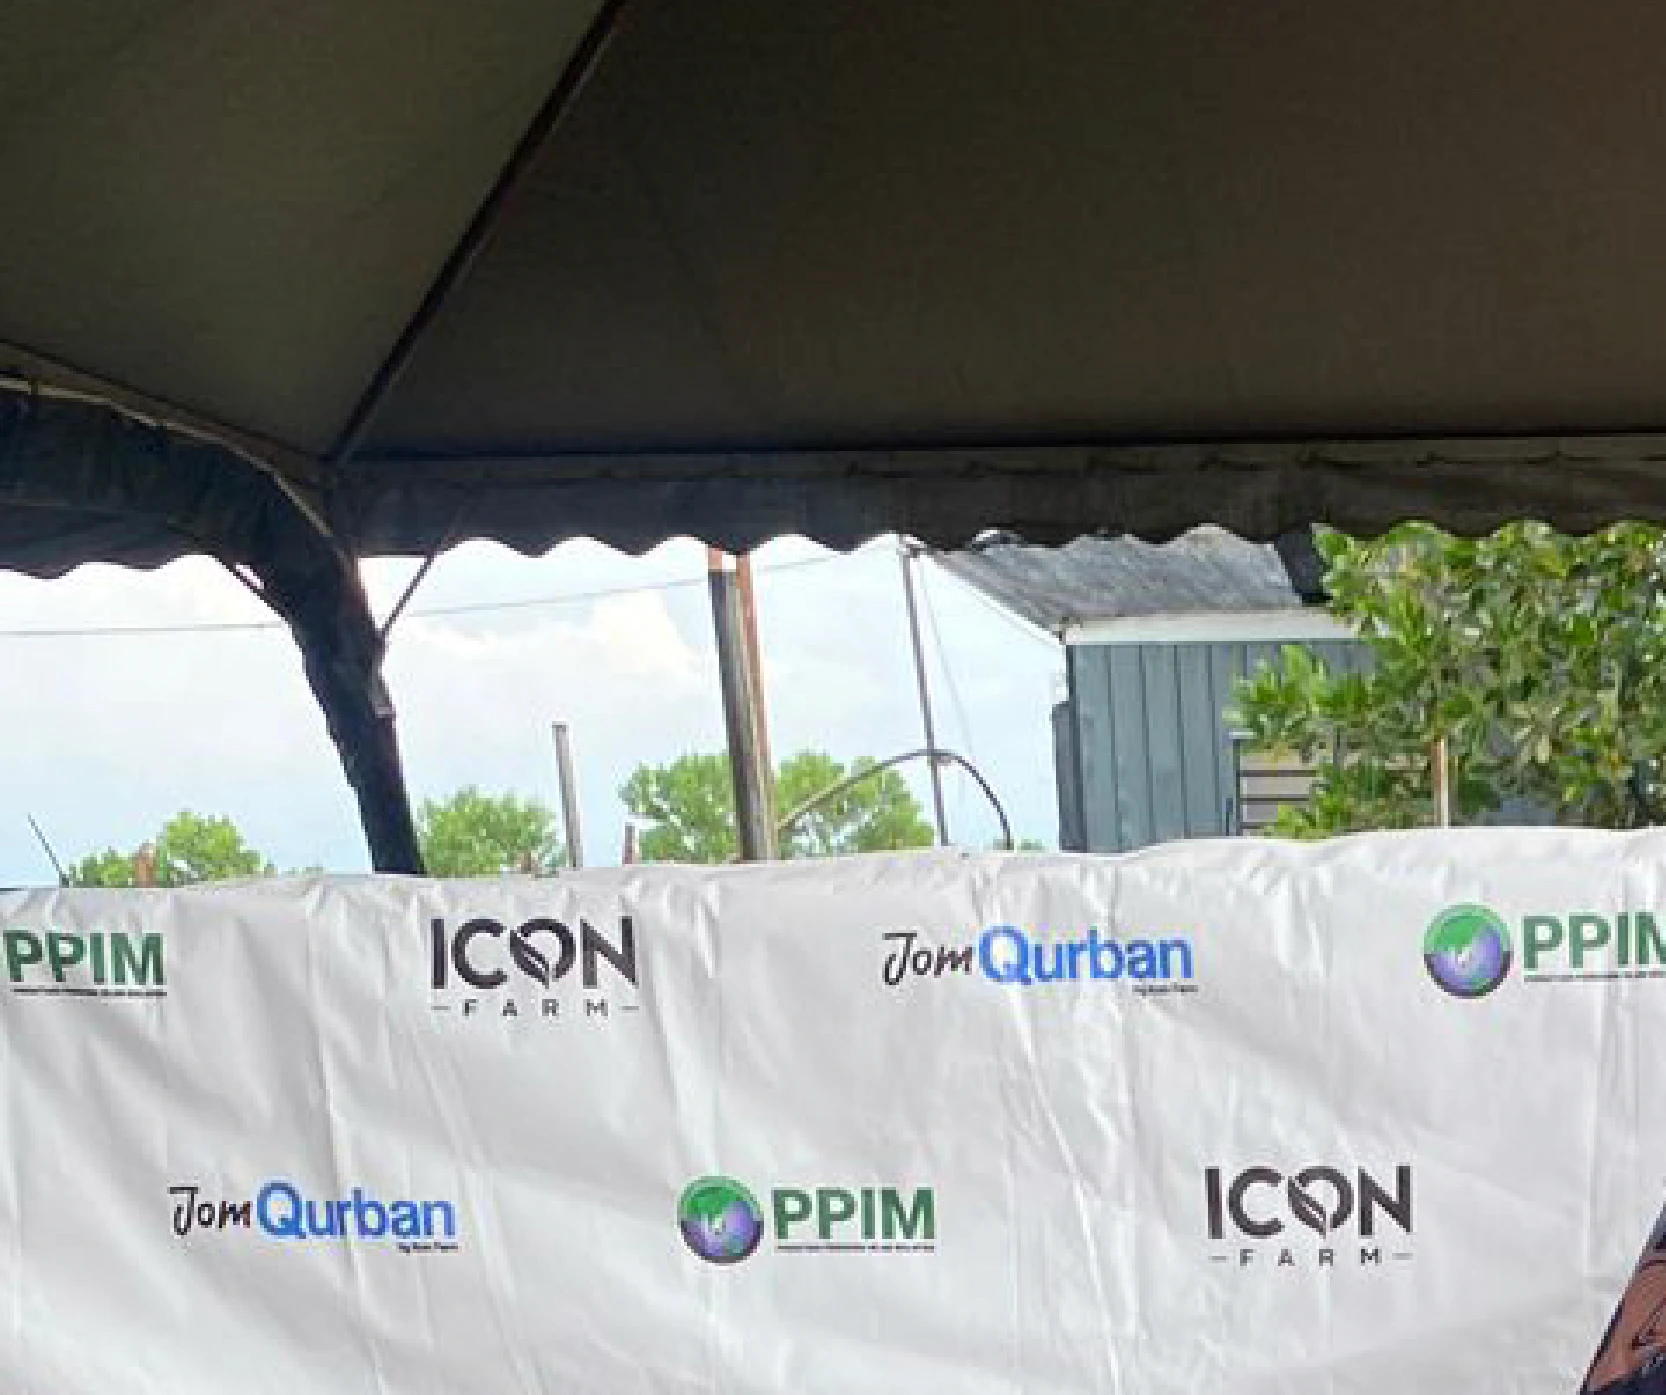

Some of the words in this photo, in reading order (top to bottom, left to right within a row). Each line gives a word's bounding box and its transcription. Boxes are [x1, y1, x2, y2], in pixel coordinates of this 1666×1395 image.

[3, 930, 164, 984] PPIM
[431, 917, 639, 989] ICON
[772, 1186, 935, 1240] PPIM
[1205, 1166, 1412, 1239] ICON
